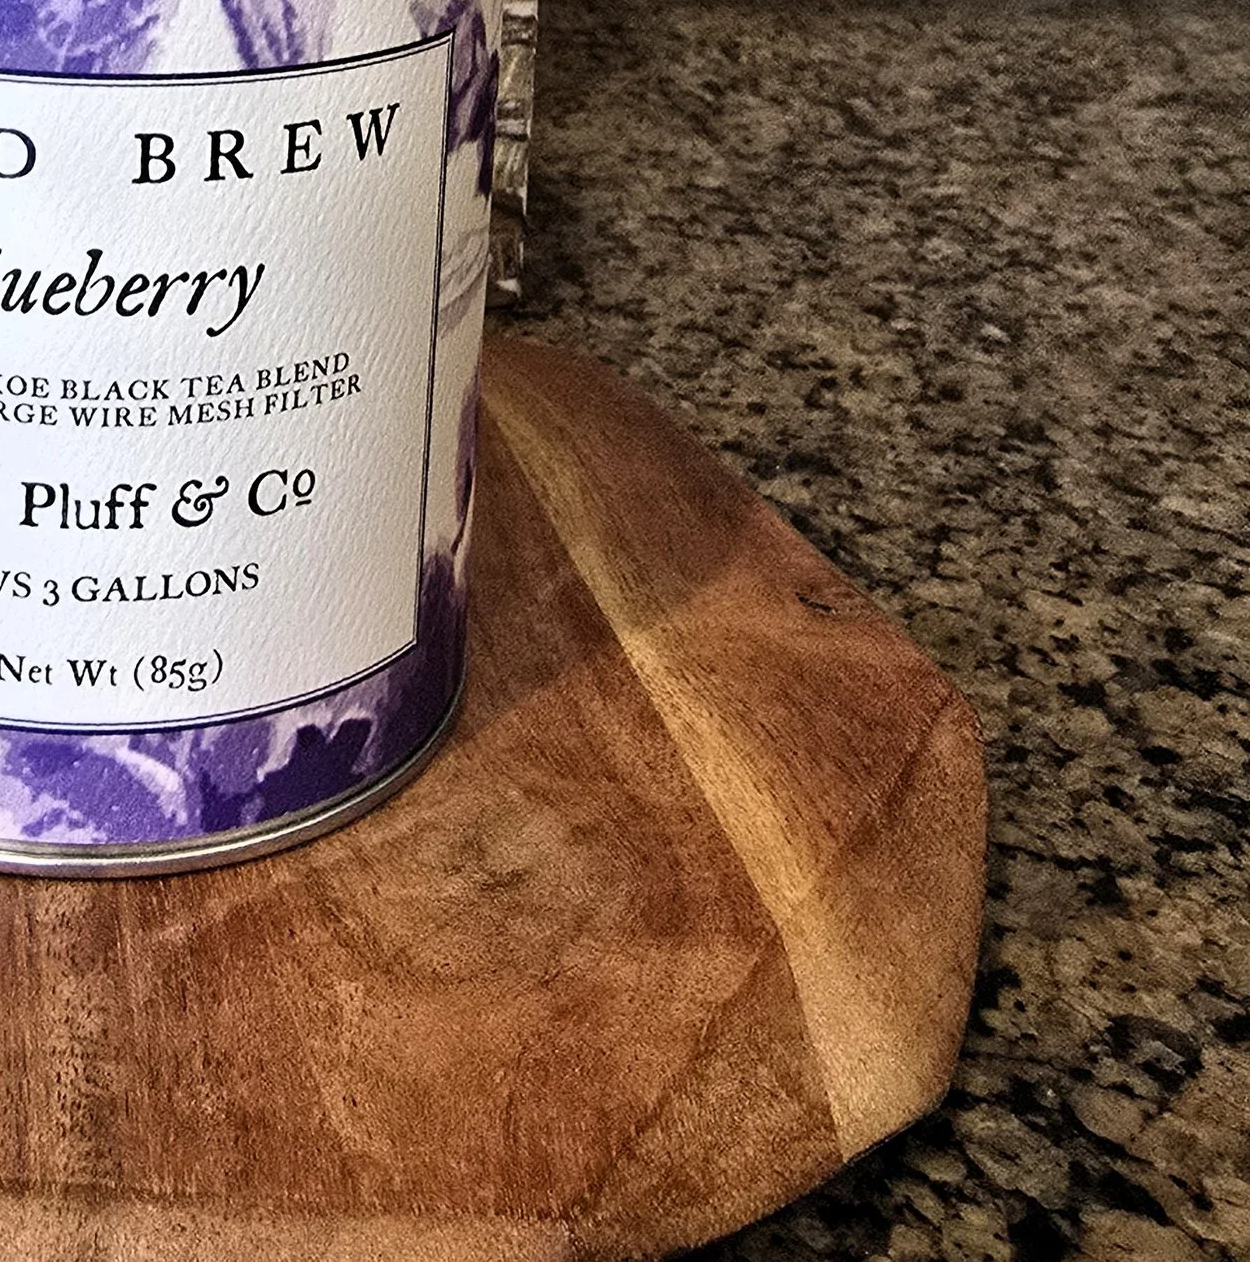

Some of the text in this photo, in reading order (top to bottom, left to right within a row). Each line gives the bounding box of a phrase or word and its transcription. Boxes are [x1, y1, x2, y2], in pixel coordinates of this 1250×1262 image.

[132, 102, 401, 185] BREW
[60, 376, 171, 401] BLACK
[179, 372, 247, 399] TEA
[255, 352, 351, 391] BLEND
[70, 405, 159, 429] WIRE
[167, 398, 255, 428] MESH
[263, 374, 363, 417] FILTER
[21, 480, 155, 531] Pluff
[171, 476, 229, 527] &
[42, 580, 60, 607] 3
[71, 562, 261, 603] GALLONS
[67, 658, 119, 688] Wt
[133, 648, 224, 692] (85g)
